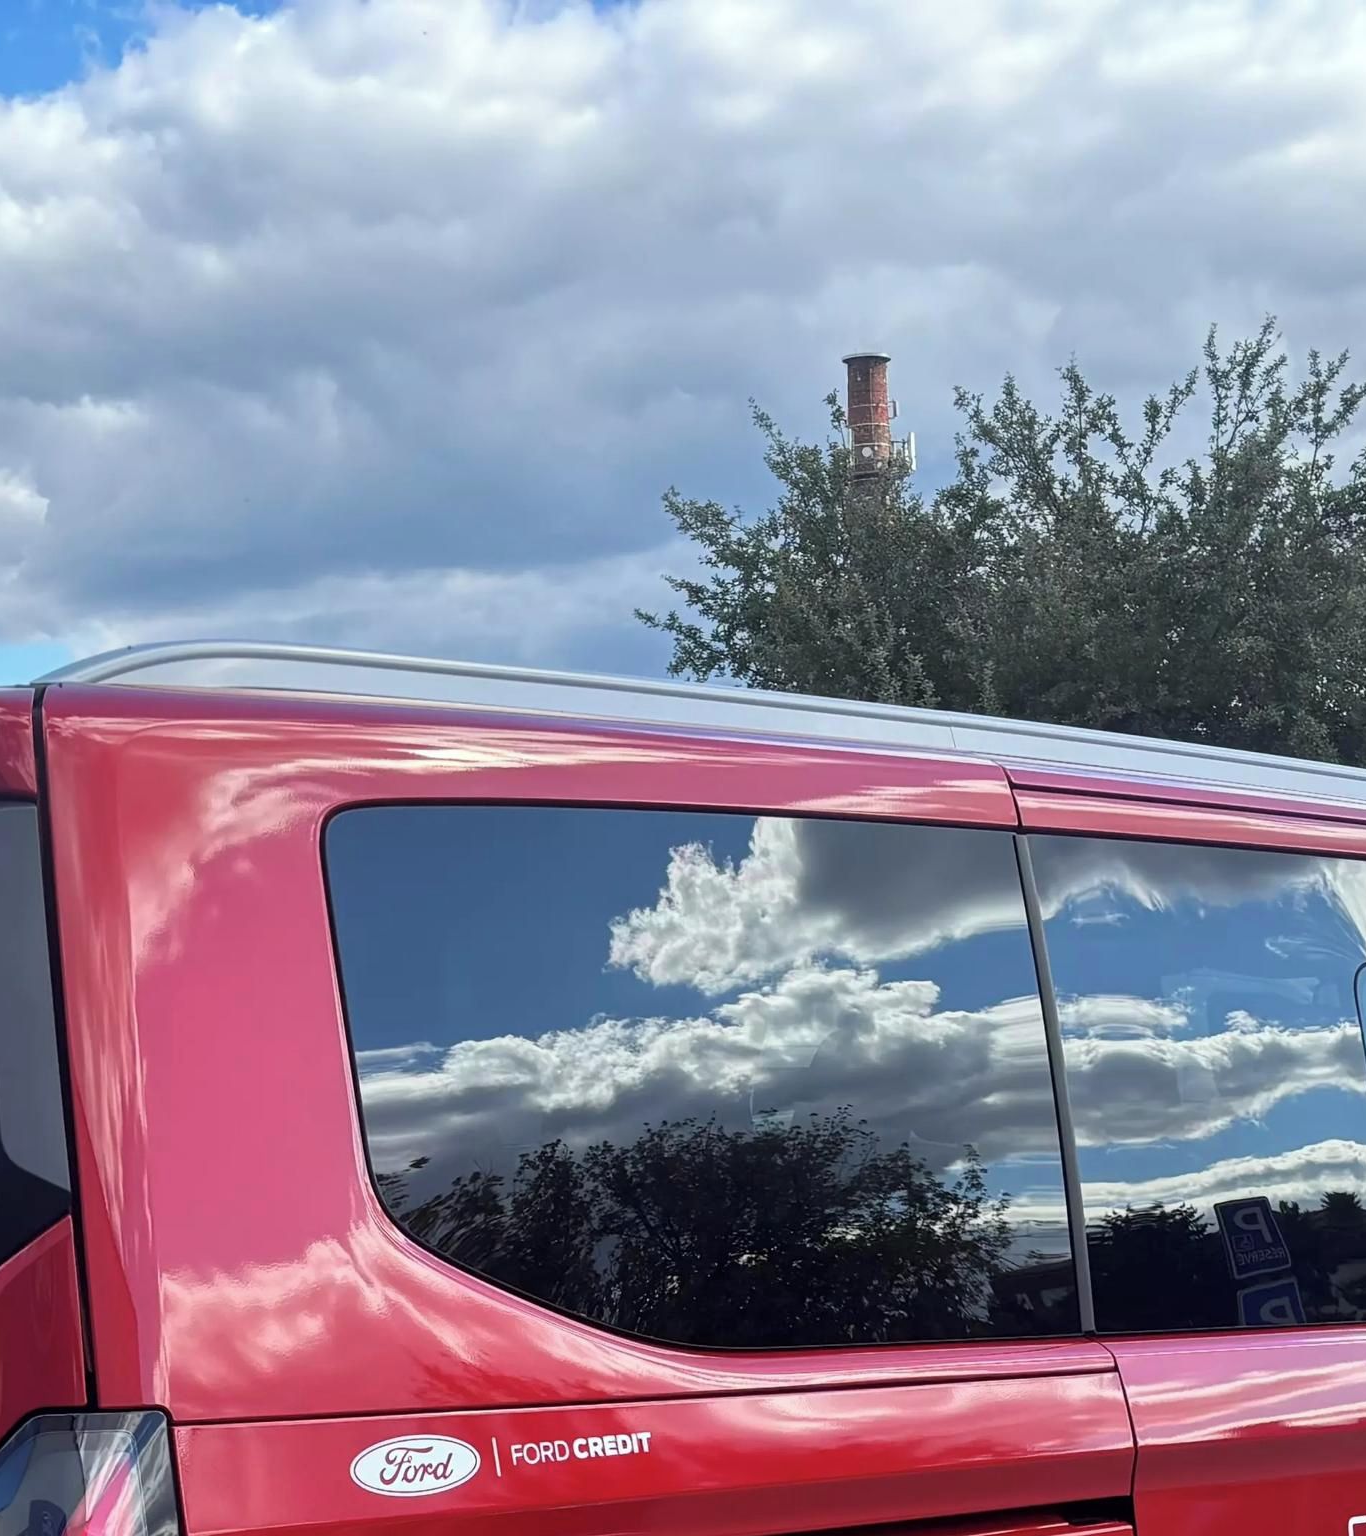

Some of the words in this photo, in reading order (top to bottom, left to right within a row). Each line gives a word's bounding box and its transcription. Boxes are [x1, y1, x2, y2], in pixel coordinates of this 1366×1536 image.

[379, 1447, 454, 1485] Ford
[511, 1440, 570, 1466] FORD
[573, 1431, 652, 1458] CREDIT
